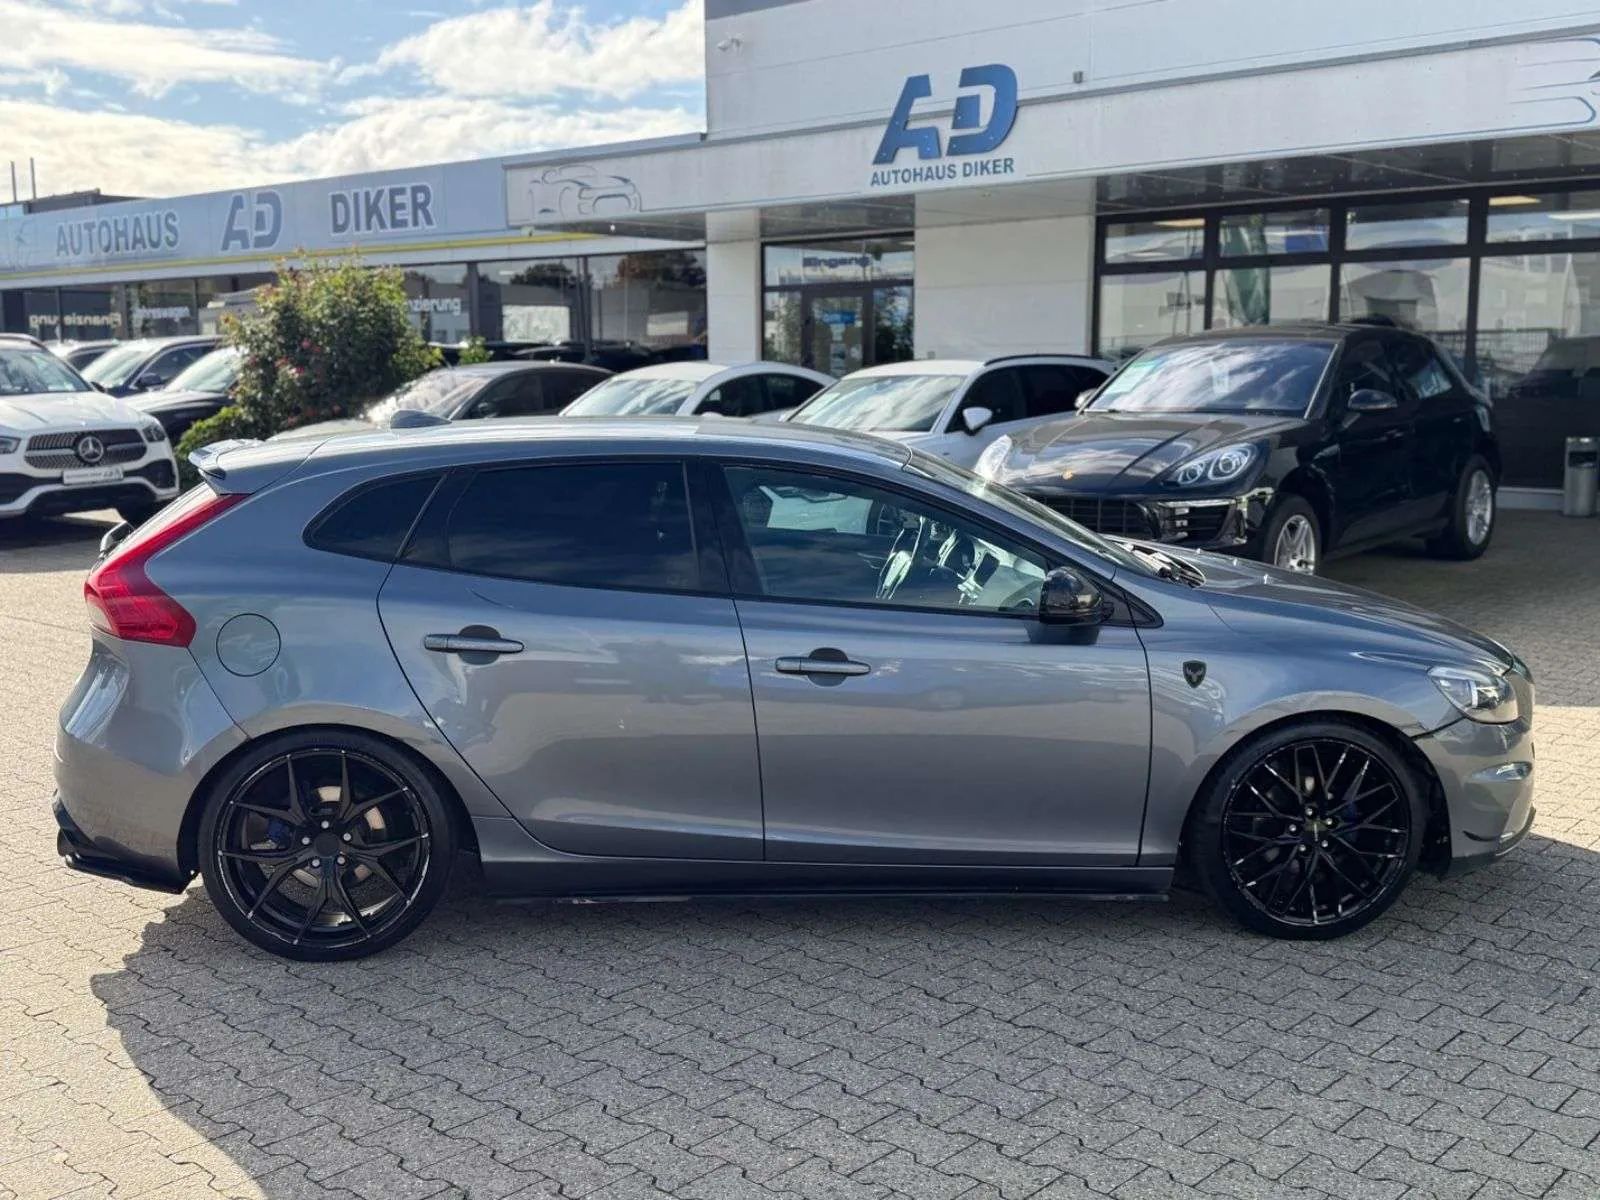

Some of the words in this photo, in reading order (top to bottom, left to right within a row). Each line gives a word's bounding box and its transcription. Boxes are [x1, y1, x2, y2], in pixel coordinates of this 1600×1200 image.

[872, 64, 1018, 165] AD
[870, 163, 957, 186] AUTOHAUS
[962, 157, 1015, 178] DIKER
[56, 211, 179, 257] AUTOHAUS
[221, 190, 282, 251] AD
[331, 184, 435, 235] DIKER
